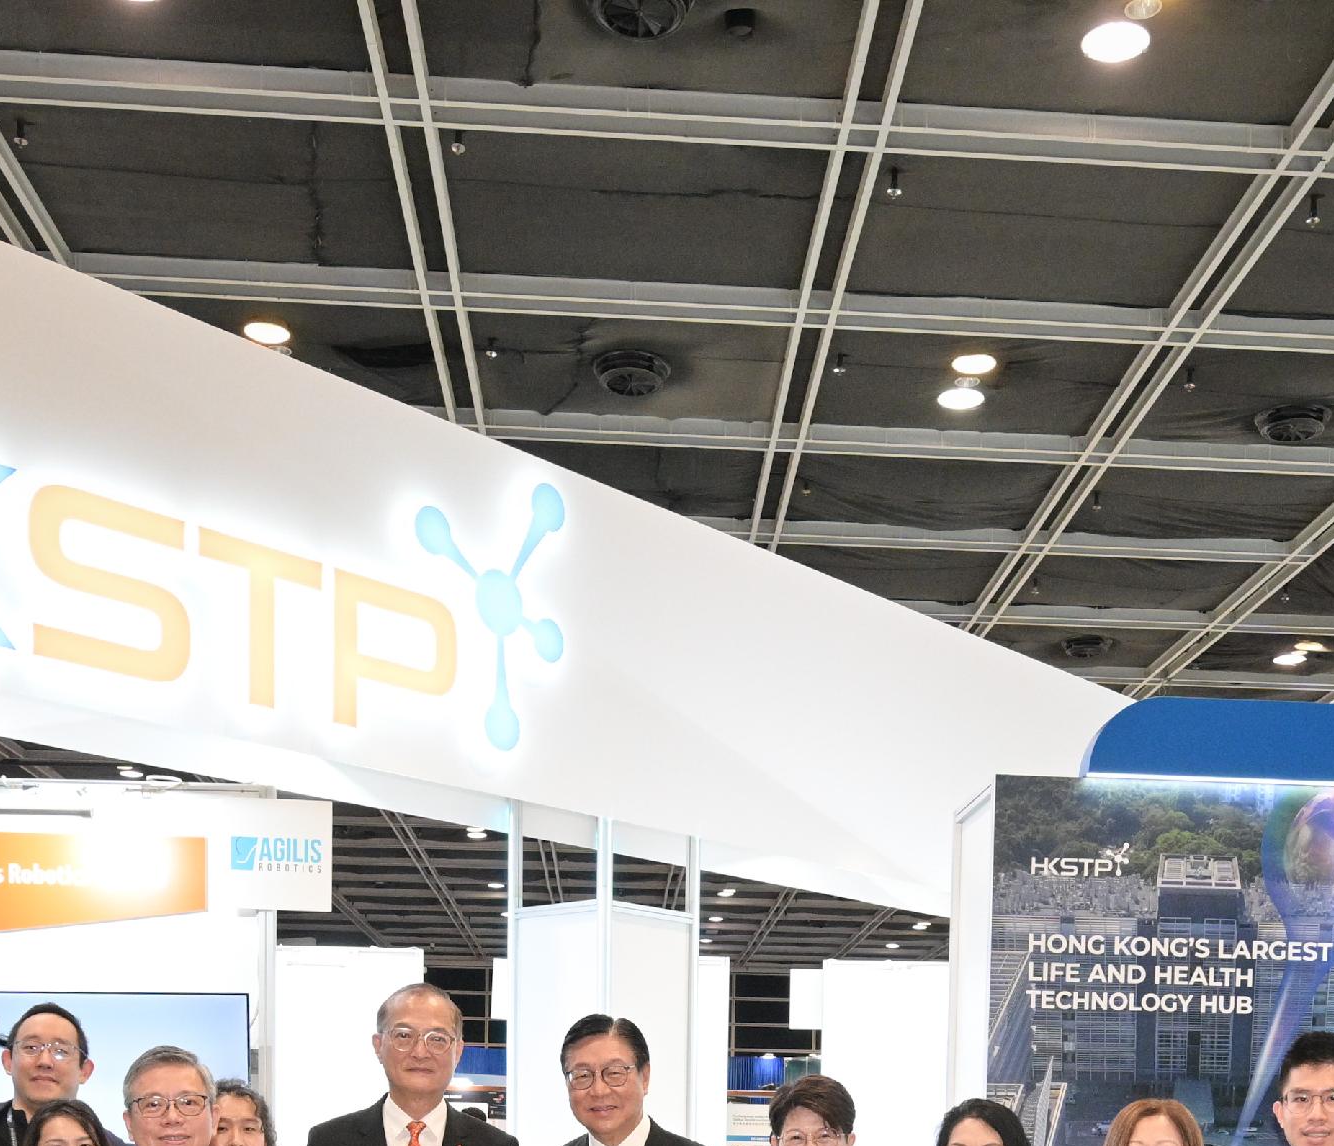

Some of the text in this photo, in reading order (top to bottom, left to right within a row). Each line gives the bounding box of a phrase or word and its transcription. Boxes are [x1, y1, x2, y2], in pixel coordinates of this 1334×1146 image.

[259, 836, 322, 864] AGILIS
[258, 863, 322, 874] ROBOTICS
[1030, 856, 1113, 877] HKSTP
[1028, 933, 1334, 962] HONG KONG'S LARGEST
[1028, 962, 1254, 988] LIFE AND HEALTH
[1026, 990, 1253, 1015] TECHNOLOGY HUB
